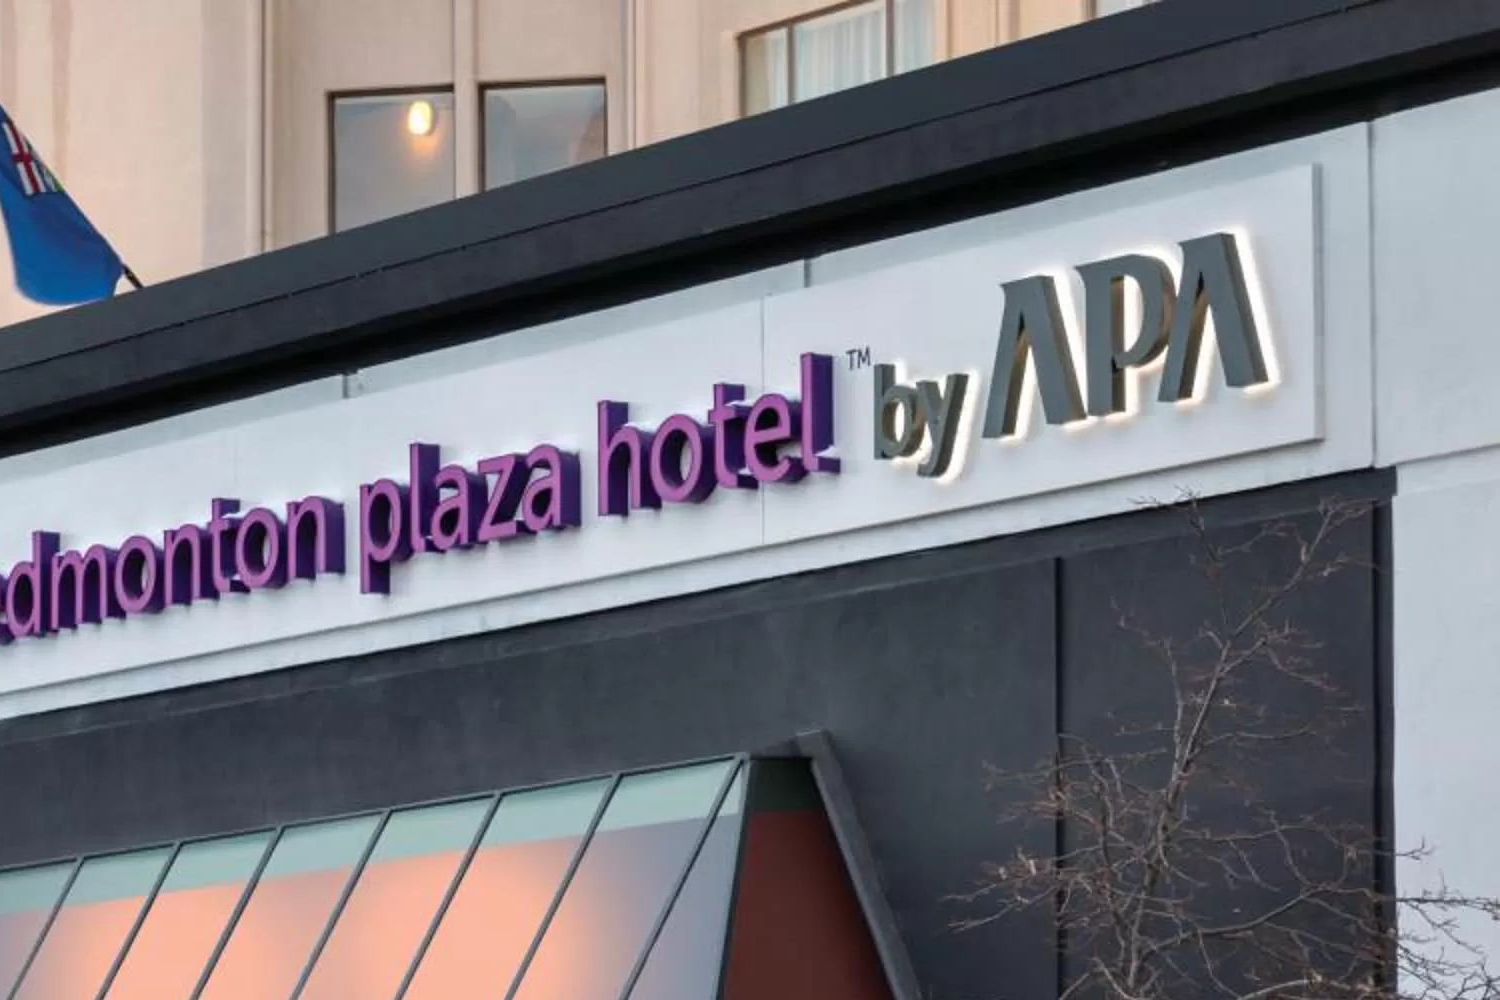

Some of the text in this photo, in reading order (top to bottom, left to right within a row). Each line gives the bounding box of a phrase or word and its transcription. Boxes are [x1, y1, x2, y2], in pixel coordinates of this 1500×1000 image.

[359, 442, 582, 595] plaza
[598, 352, 841, 517] hotel
[874, 364, 970, 478] by
[983, 232, 1270, 439] APA
